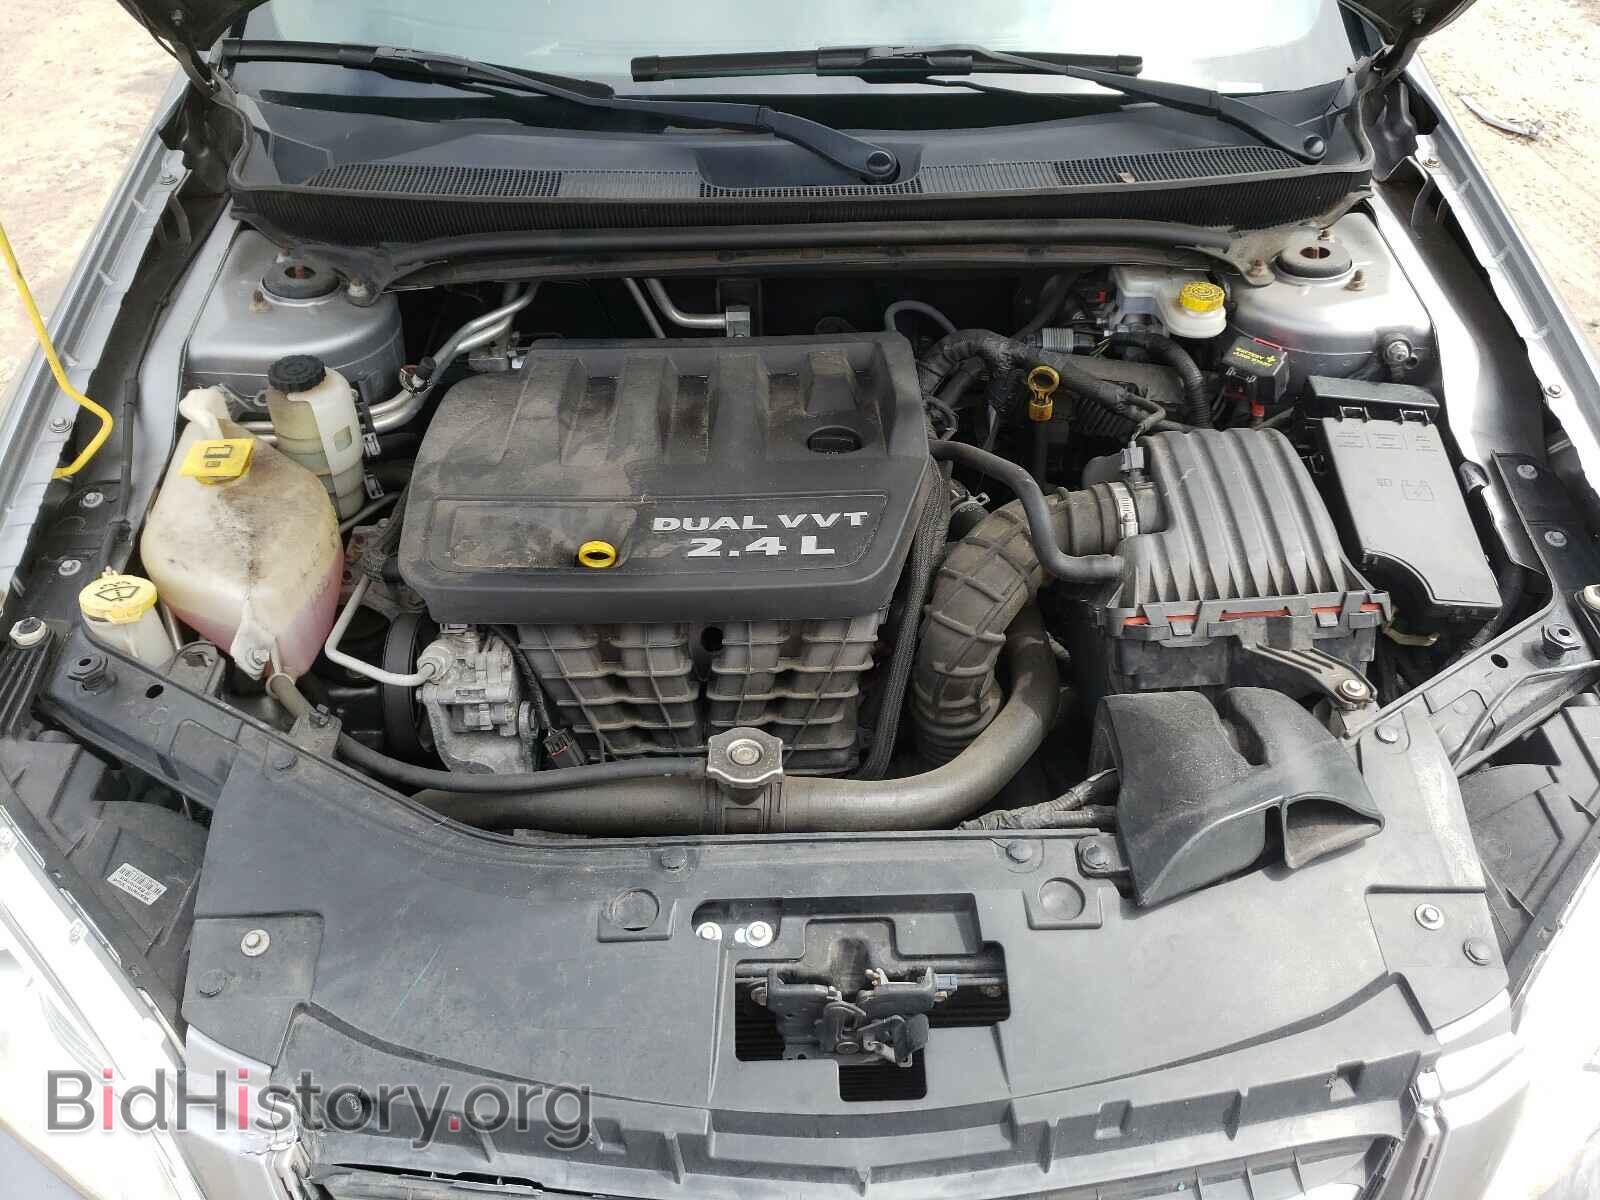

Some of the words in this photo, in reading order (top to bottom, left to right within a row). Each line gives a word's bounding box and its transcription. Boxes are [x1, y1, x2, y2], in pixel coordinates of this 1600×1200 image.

[653, 516, 768, 531] DUAL
[777, 511, 868, 529] VVT
[687, 536, 787, 557] 2.4
[800, 535, 835, 555] L
